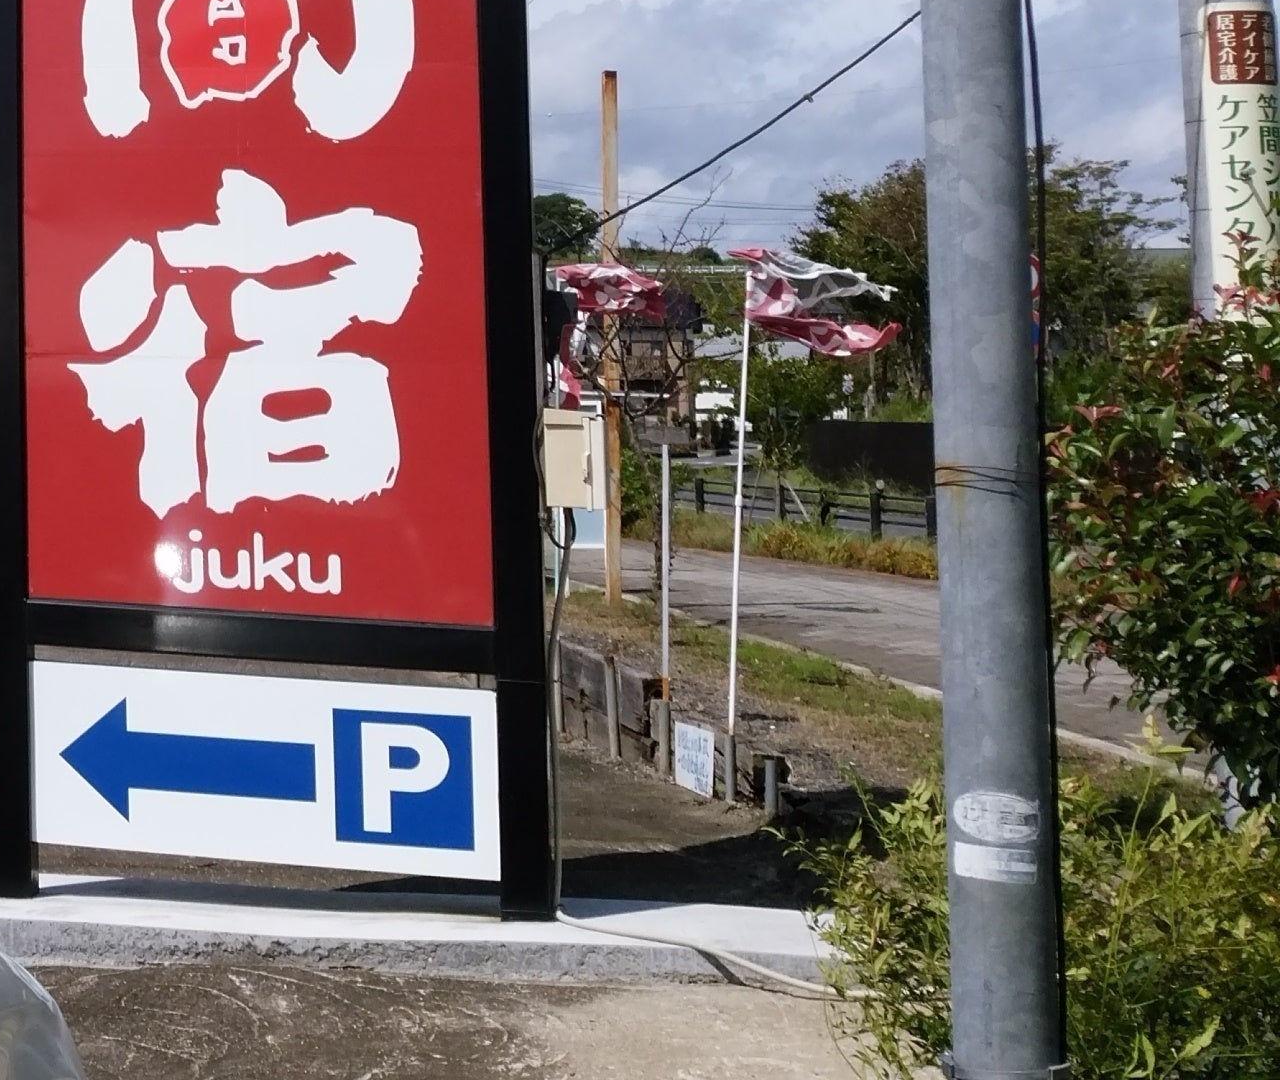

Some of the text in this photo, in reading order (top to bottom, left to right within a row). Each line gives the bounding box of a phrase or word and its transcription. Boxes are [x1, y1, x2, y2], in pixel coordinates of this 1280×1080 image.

[1216, 13, 1239, 81] 居宅介護
[1241, 14, 1259, 80] デイケア
[173, 529, 341, 595] juku
[361, 722, 450, 834] P
